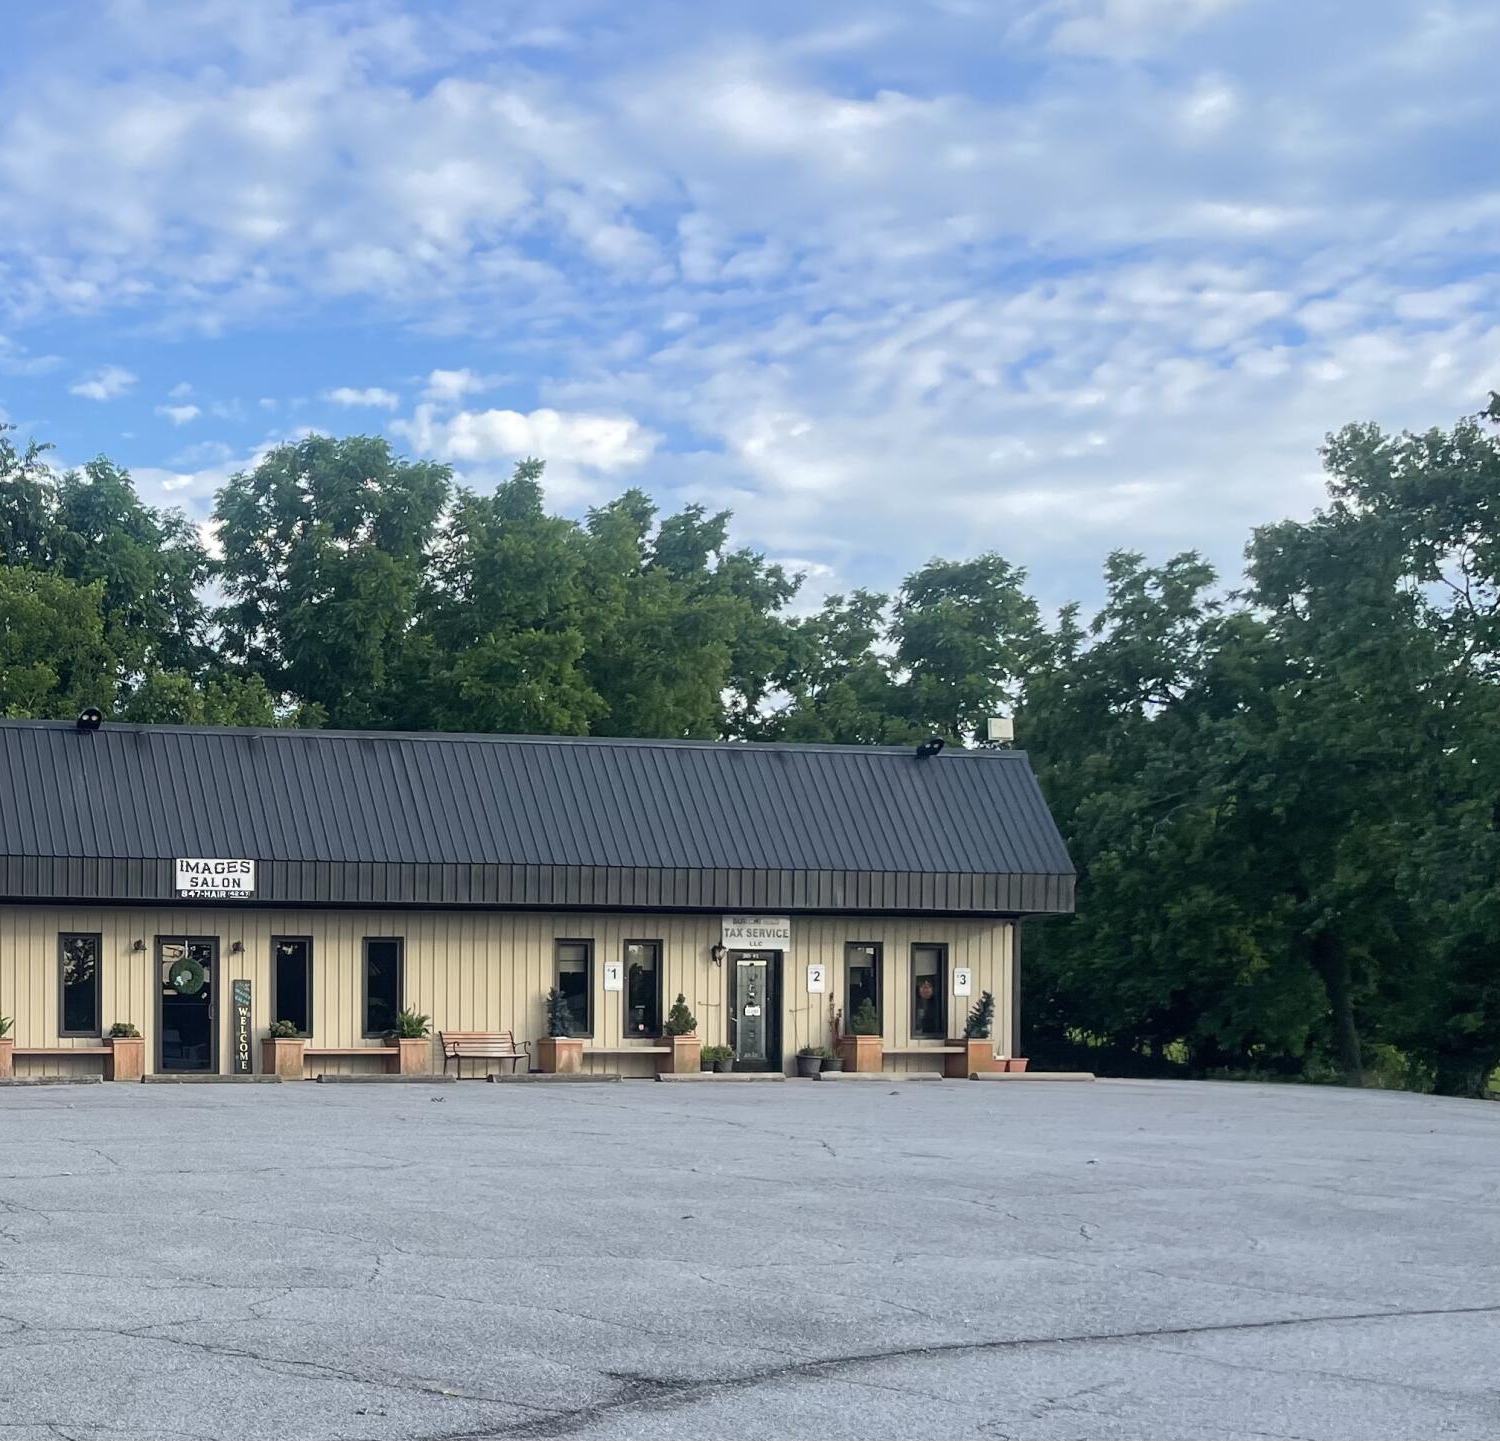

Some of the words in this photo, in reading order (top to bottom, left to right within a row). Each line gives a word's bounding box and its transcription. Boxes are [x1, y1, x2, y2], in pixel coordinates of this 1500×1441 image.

[180, 860, 251, 874] IMAGES
[190, 877, 241, 888] SALON
[181, 890, 226, 898] 847-HAIR
[725, 928, 743, 938] TAX
[747, 928, 789, 938] SERVICE
[239, 1007, 249, 1070] WELCOME
